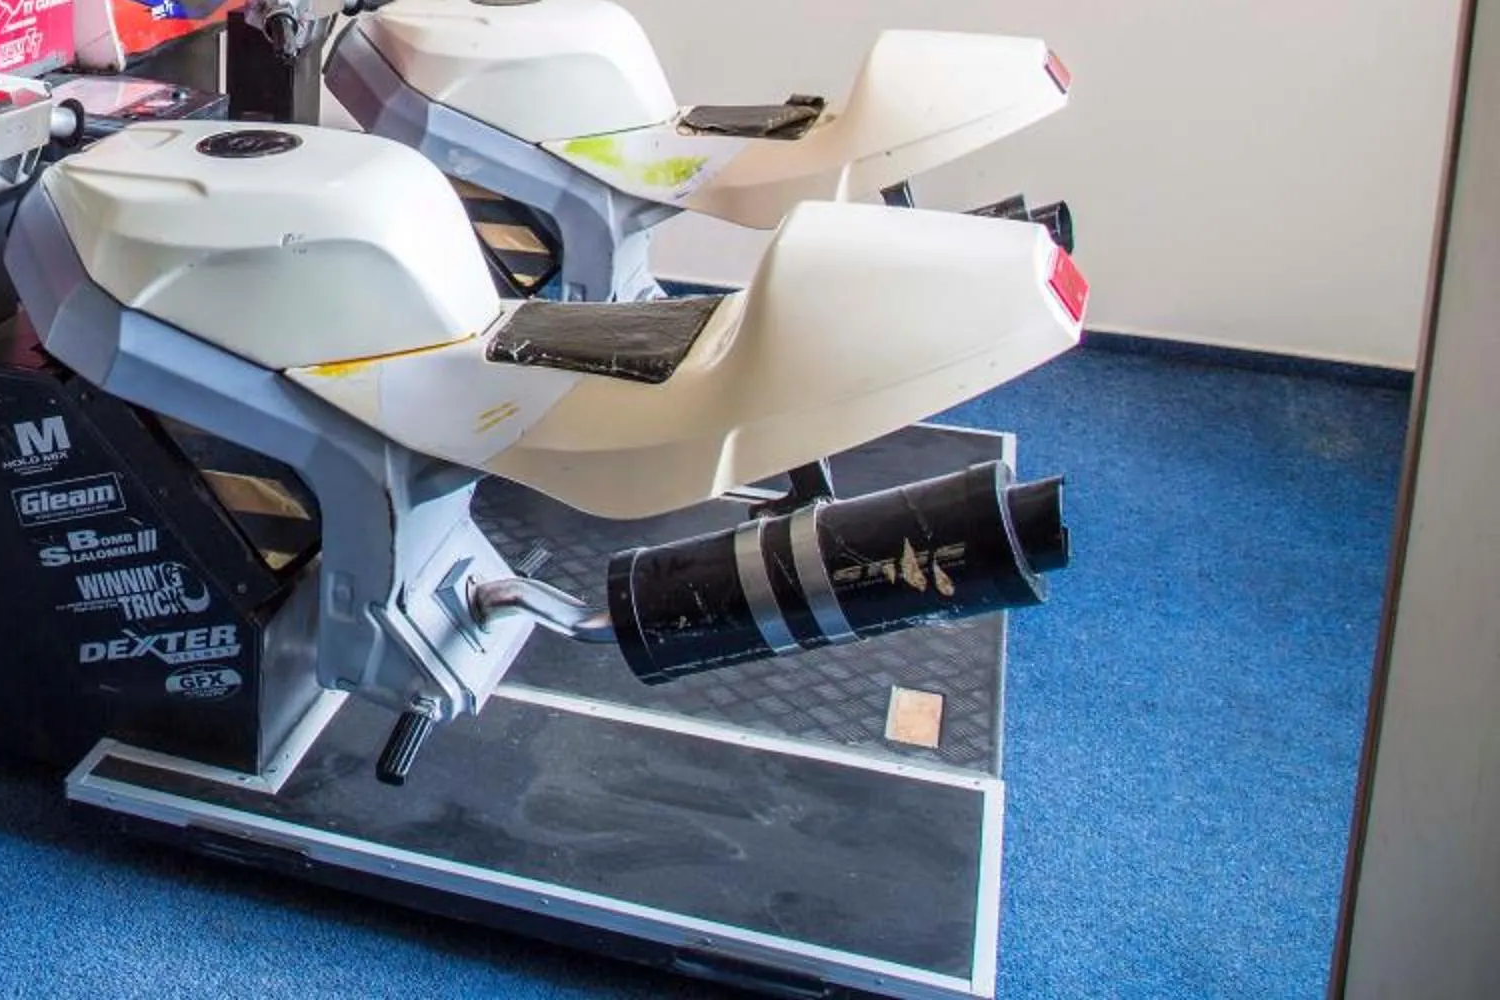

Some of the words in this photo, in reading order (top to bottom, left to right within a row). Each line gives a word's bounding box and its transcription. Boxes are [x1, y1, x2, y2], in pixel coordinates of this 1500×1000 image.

[13, 416, 71, 457] M
[21, 484, 116, 515] Gleam
[79, 624, 237, 664] DEXTER
[180, 671, 227, 688] GFX
